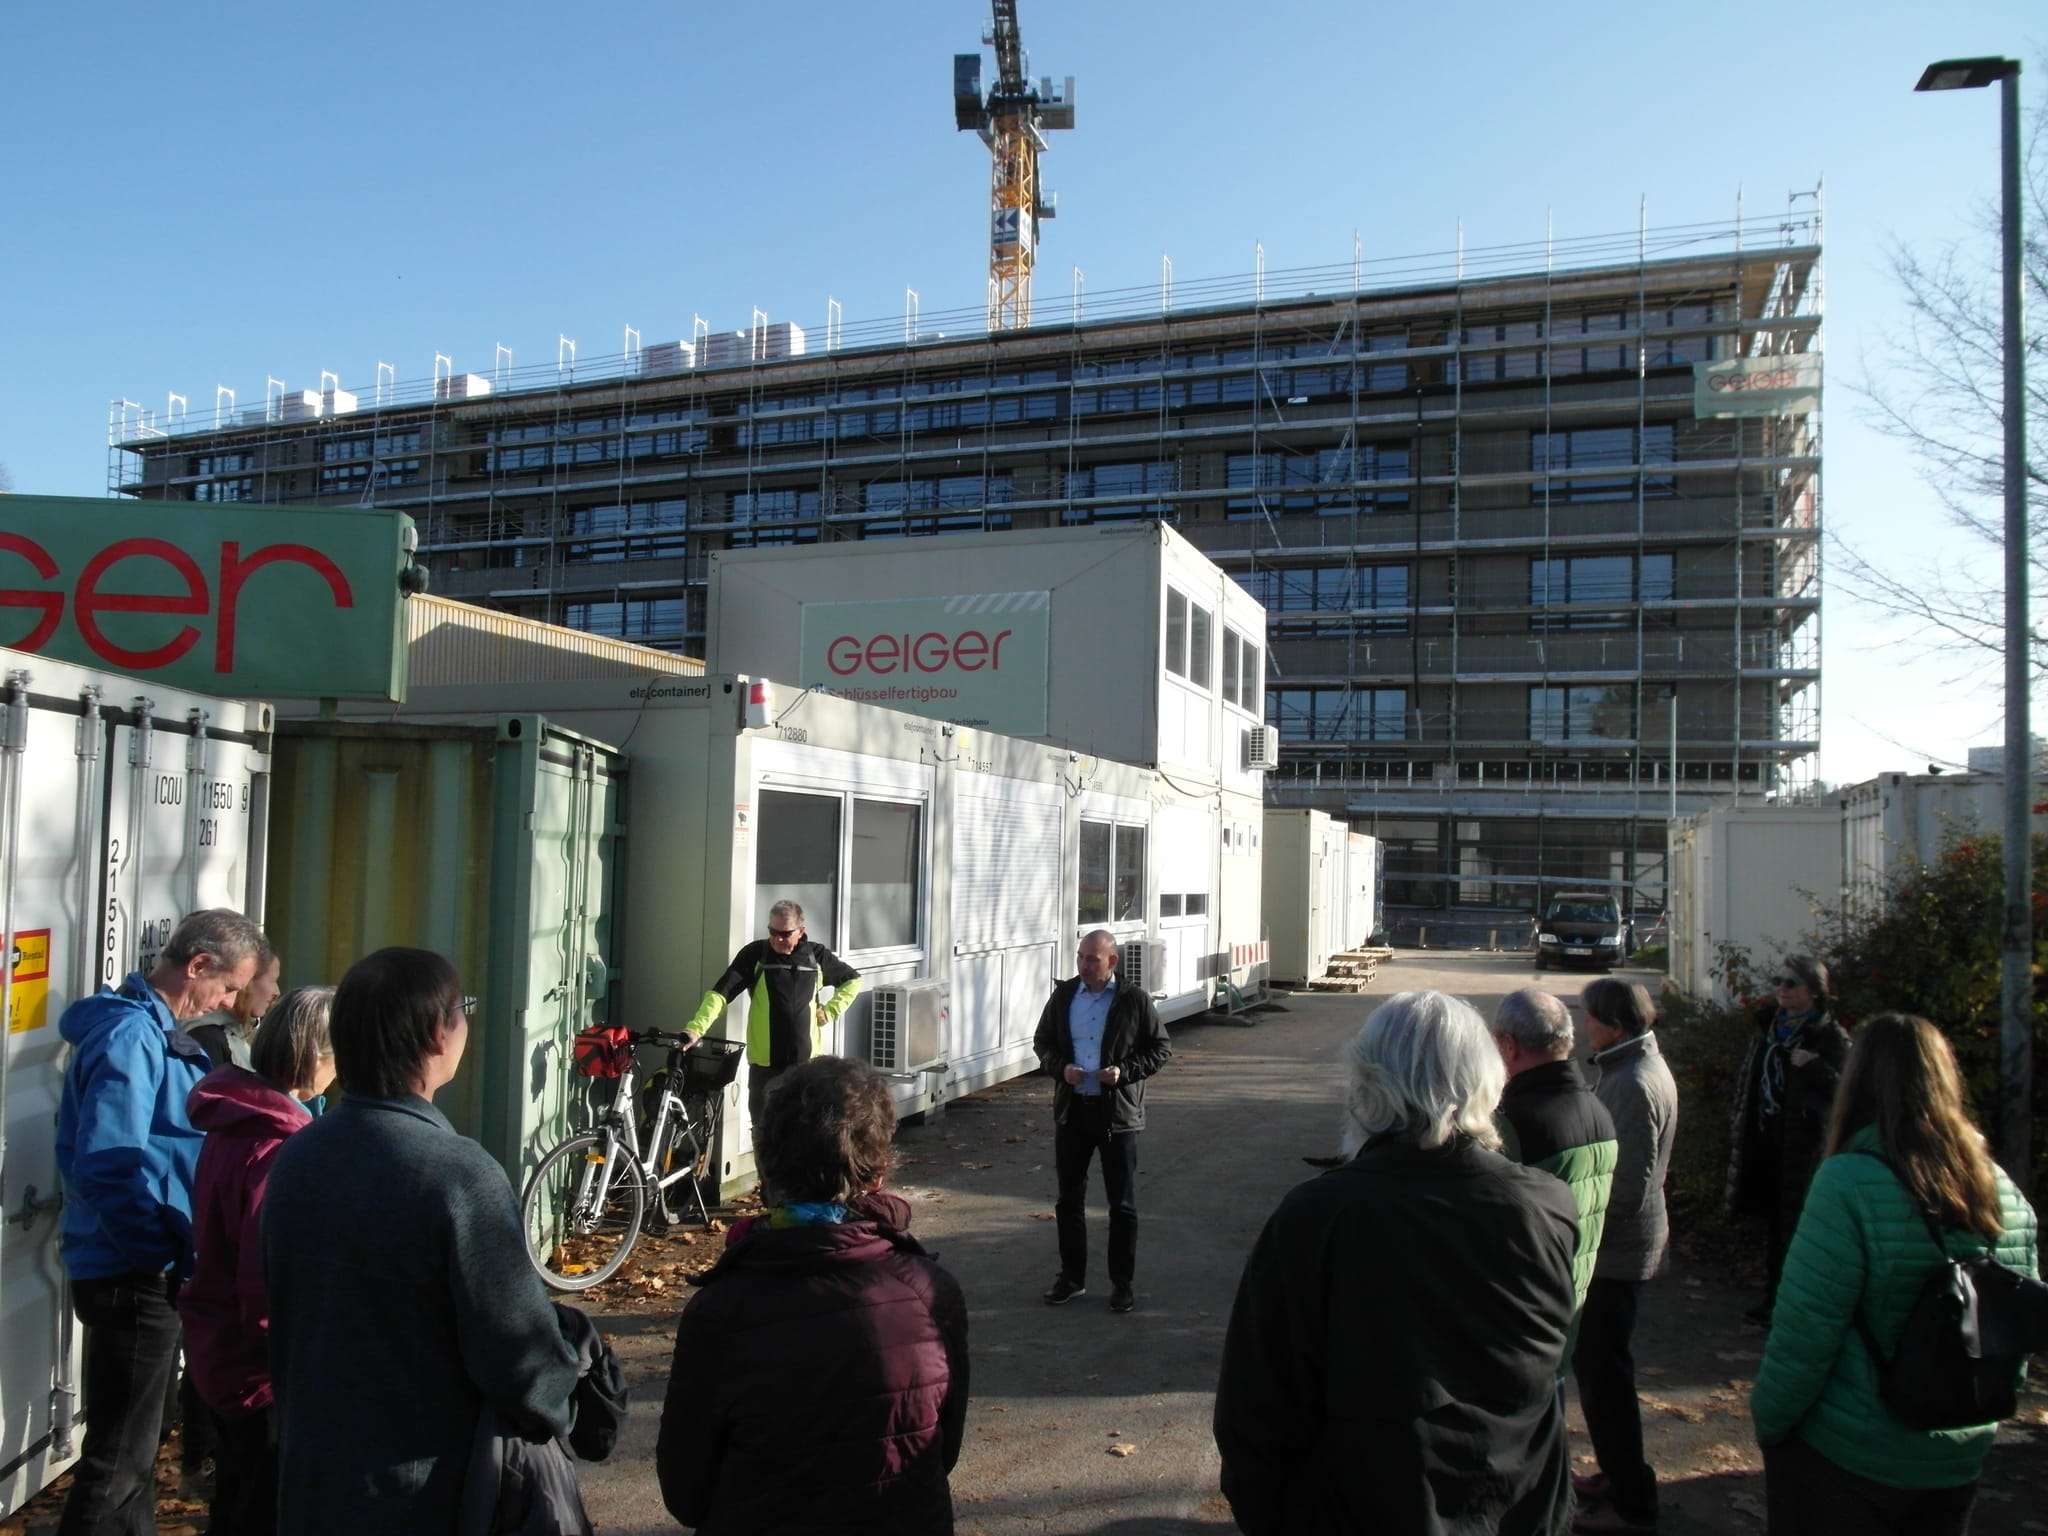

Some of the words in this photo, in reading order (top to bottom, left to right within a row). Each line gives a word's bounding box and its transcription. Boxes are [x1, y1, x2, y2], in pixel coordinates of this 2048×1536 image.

[629, 684, 711, 700] ela[container]
[777, 726, 808, 743] 712880
[154, 775, 183, 805] ICOU
[141, 919, 157, 949] AX.
